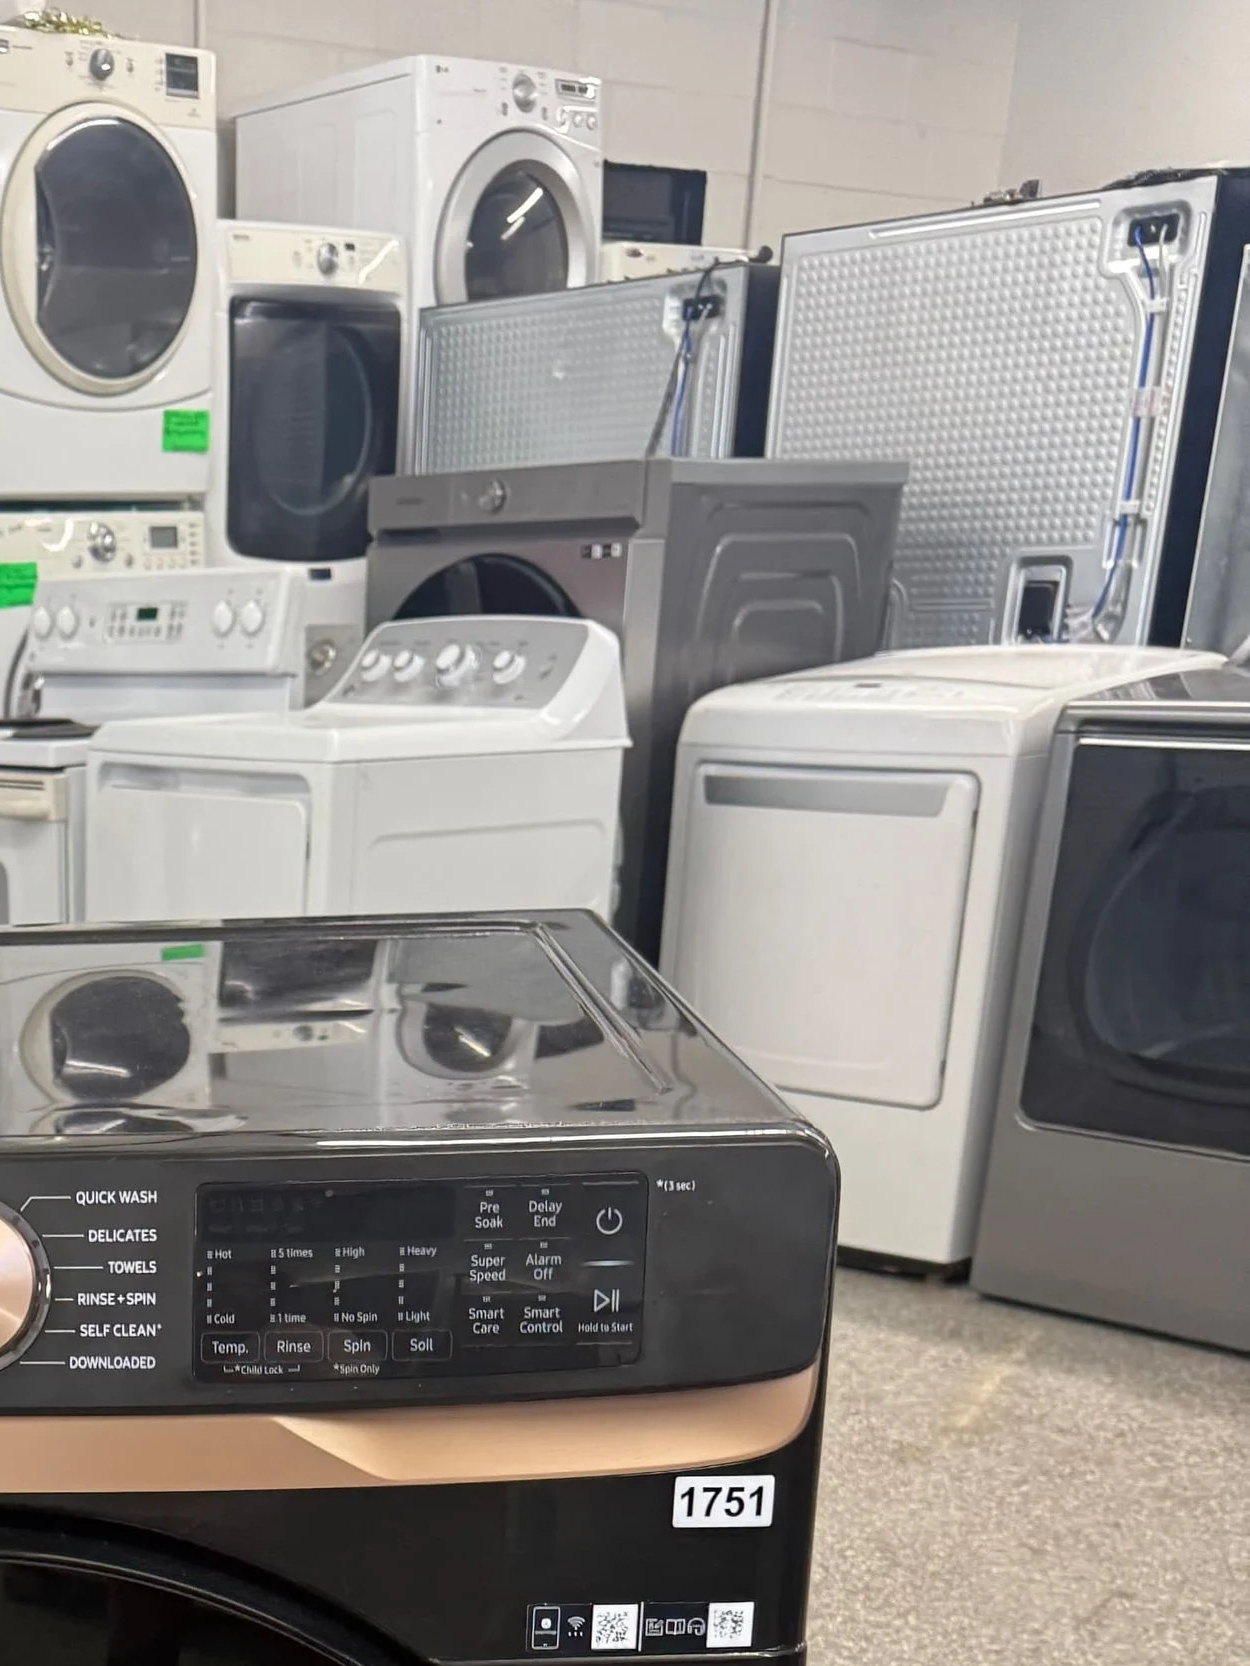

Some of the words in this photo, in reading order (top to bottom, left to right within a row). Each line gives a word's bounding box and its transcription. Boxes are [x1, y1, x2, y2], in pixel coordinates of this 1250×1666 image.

[675, 1179, 696, 1191] sec)
[75, 1190, 116, 1206] QUICK
[118, 1190, 158, 1204] WASH
[479, 1201, 500, 1214] Pre
[528, 1199, 563, 1217] Delay
[474, 1215, 503, 1229] Soak
[533, 1214, 557, 1228] End
[88, 1228, 158, 1243] DELICATES
[214, 1249, 232, 1260] Hot
[278, 1247, 285, 1259] 5
[286, 1247, 313, 1258] times
[342, 1246, 365, 1260] High
[407, 1245, 437, 1258] Heavy
[470, 1254, 506, 1271] Super
[525, 1253, 562, 1266] Alarm
[107, 1260, 157, 1274] TOWELS
[533, 1267, 553, 1281] Off
[469, 1268, 506, 1284] Speed
[77, 1292, 116, 1306] RINSE
[126, 1292, 157, 1306] SPIN
[213, 1313, 235, 1325] Cold
[284, 1313, 307, 1323] time
[341, 1312, 355, 1323] No
[356, 1311, 378, 1324] Spin
[405, 1310, 430, 1323] Light
[468, 1307, 504, 1320] Smart
[523, 1306, 560, 1319] Smart
[79, 1323, 110, 1337] SELF
[472, 1321, 500, 1335] Care
[519, 1319, 563, 1334] Control
[578, 1322, 599, 1333] Hold
[600, 1323, 610, 1333] to
[611, 1321, 633, 1333] Start
[212, 1340, 249, 1356] Temp.
[277, 1339, 311, 1353] Rinse
[343, 1338, 371, 1355] Spin
[410, 1337, 434, 1352] Soil
[69, 1355, 156, 1370] DOWNLOADED
[264, 1364, 284, 1375] Lock
[359, 1363, 380, 1375] Only
[680, 1486, 764, 1518] 1751
